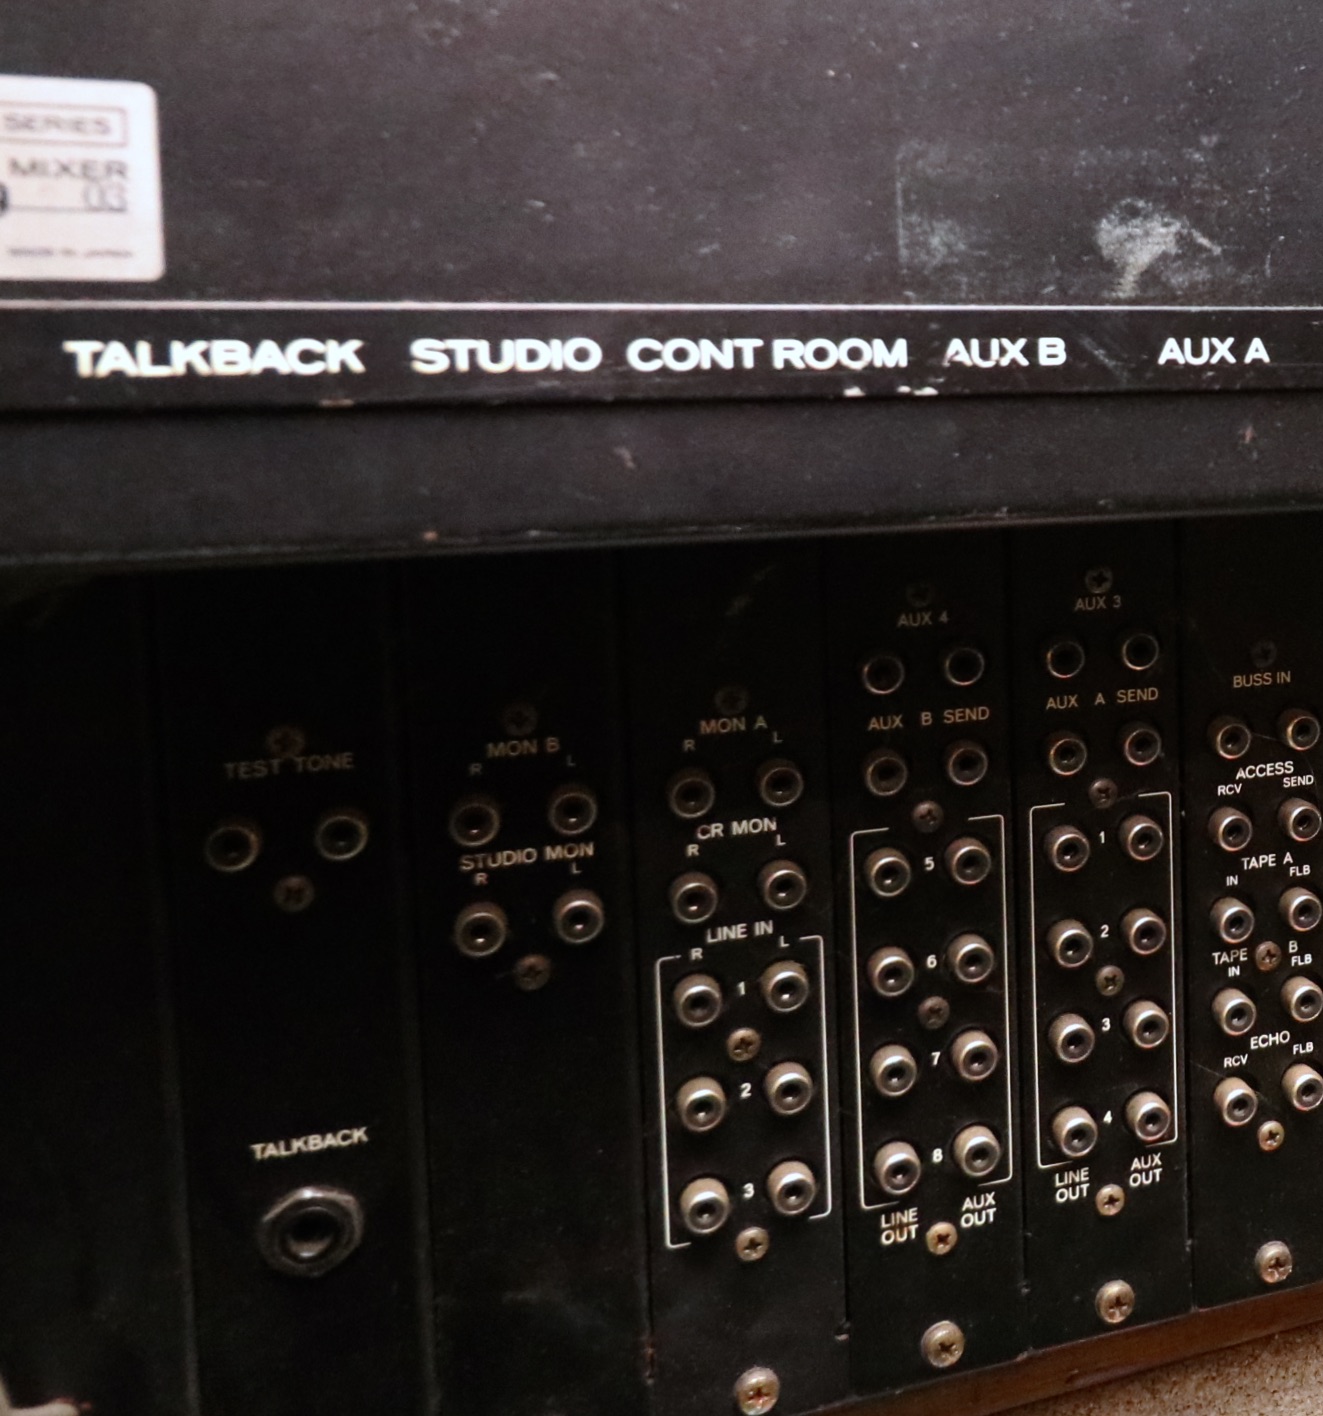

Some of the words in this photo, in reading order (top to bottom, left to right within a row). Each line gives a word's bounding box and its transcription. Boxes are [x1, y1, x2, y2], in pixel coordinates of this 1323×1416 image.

[9, 158, 128, 180] MIXER
[63, 338, 365, 377] TALKBACK
[410, 337, 602, 373] STUDIO
[626, 338, 764, 371] CONT
[773, 338, 908, 370] ROOM
[943, 337, 1029, 368] AUX
[1038, 337, 1067, 366] B
[1158, 337, 1235, 366] AUX
[1243, 337, 1271, 365] A
[1074, 595, 1106, 613] AUX
[1112, 595, 1122, 607] 3
[896, 611, 932, 629] AUX
[938, 610, 950, 623] 4
[1233, 672, 1272, 688] BUSS
[1276, 671, 1291, 684] IN
[1046, 694, 1079, 711] AUX
[1094, 692, 1106, 706] A
[1116, 687, 1159, 703] SEND
[699, 716, 746, 735] MON
[754, 715, 768, 730] A
[867, 714, 904, 732] AUX
[921, 711, 933, 725] B
[943, 706, 990, 724] SEND
[683, 739, 696, 752] R
[772, 731, 783, 744] L
[485, 738, 538, 759] MON
[544, 737, 560, 752] B
[225, 758, 281, 781] TEST
[293, 752, 355, 774] TONE
[468, 762, 483, 776] R
[566, 754, 576, 768] L
[1236, 761, 1294, 780] ACCESS
[1217, 784, 1242, 796] RCV
[1282, 775, 1314, 788] SEND
[697, 823, 724, 841] CR
[731, 817, 777, 836] MON
[1099, 831, 1106, 844] 1
[776, 834, 786, 847] L
[458, 847, 538, 873] STUDIO
[543, 841, 594, 862] MON
[686, 844, 700, 857] R
[570, 862, 582, 875] L
[924, 856, 935, 871] 5
[1241, 854, 1276, 871] TAPE
[1283, 852, 1294, 865] A
[473, 872, 489, 886] R
[1290, 864, 1311, 878] FLB
[1226, 875, 1238, 886] IN
[705, 923, 747, 944] LINE
[754, 920, 774, 936] IN
[1100, 925, 1109, 939] 2
[779, 935, 790, 948] L
[690, 947, 704, 961] R
[926, 954, 937, 969] 6
[1212, 948, 1248, 966] TAPE
[1288, 940, 1298, 953] B
[1291, 954, 1312, 966] FLB
[1228, 966, 1240, 977] IN
[736, 981, 746, 996] 1
[1102, 1018, 1110, 1032] 3
[1250, 1030, 1290, 1050] ECHO
[1292, 1042, 1314, 1055] FLB
[931, 1052, 941, 1066] 7
[1224, 1054, 1248, 1068] RCV
[740, 1083, 752, 1098] 2
[1103, 1111, 1113, 1124] 4
[249, 1126, 369, 1161] TALKBACK
[932, 1148, 943, 1163] 8
[1130, 1152, 1162, 1172] AUX
[1054, 1167, 1090, 1188] LINE
[1129, 1168, 1162, 1188] OUT
[743, 1183, 755, 1198] 3
[1055, 1184, 1090, 1203] OUT
[961, 1192, 996, 1211] AUX
[880, 1207, 918, 1228] LINE
[960, 1209, 996, 1228] OUT
[880, 1226, 919, 1246] OUT
